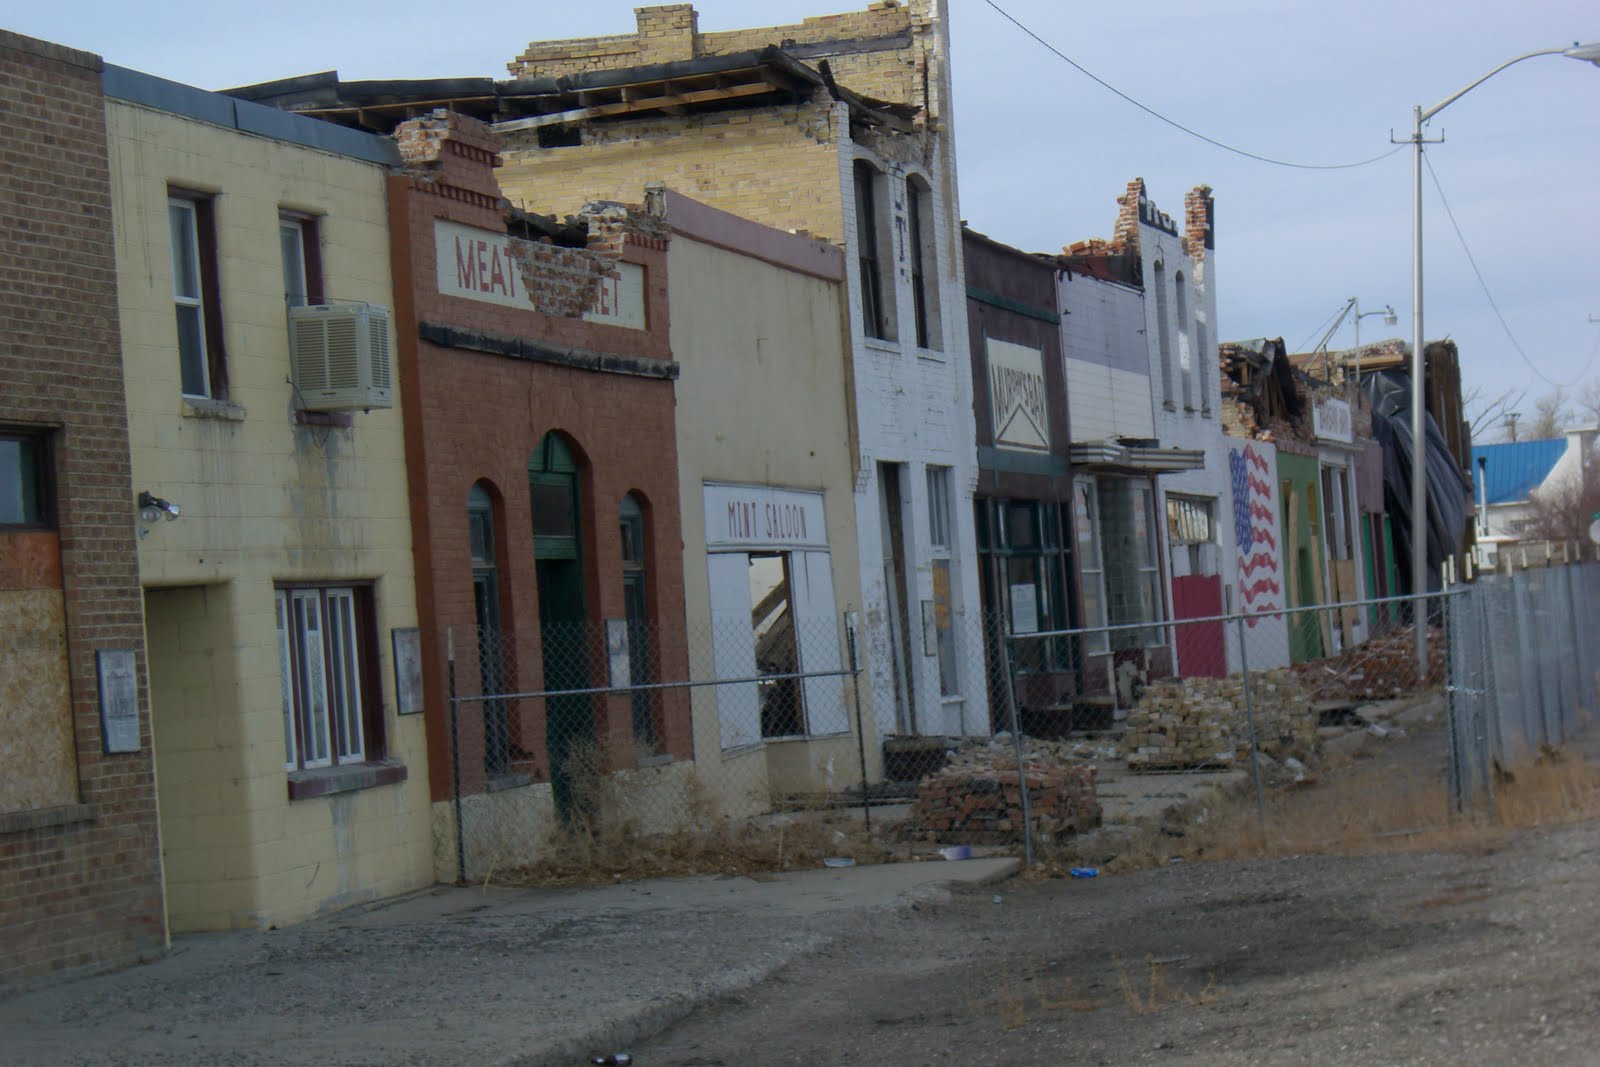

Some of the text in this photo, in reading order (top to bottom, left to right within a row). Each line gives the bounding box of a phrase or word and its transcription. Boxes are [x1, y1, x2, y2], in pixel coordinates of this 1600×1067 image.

[455, 236, 515, 297] MEAT
[728, 502, 807, 539] MINT SALOON
